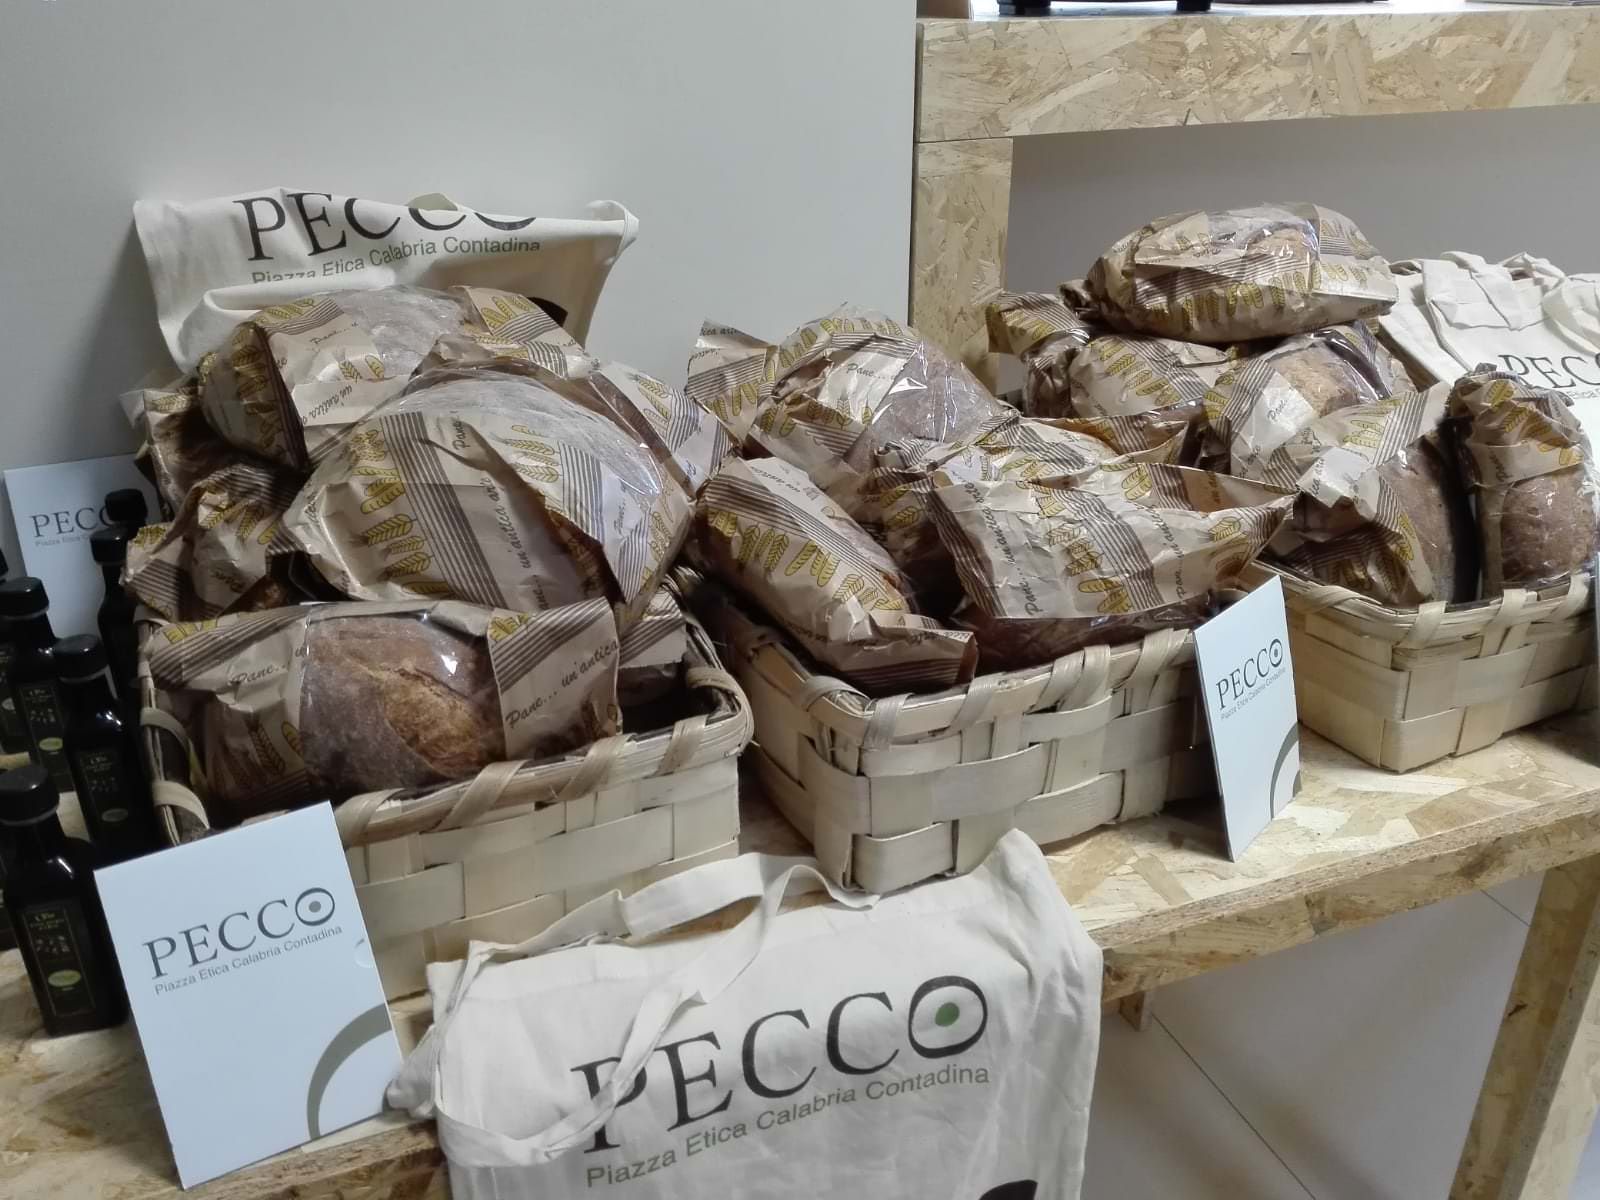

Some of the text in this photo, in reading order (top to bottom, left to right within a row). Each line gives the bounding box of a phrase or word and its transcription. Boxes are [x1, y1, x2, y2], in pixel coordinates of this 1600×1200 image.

[232, 192, 537, 261] PEC
[322, 256, 365, 277] Etica
[369, 239, 437, 266] Calabria
[443, 236, 541, 254] Contadina
[1497, 353, 1600, 389] PEC
[31, 506, 113, 538] PEC
[1215, 638, 1283, 711] PECCO
[142, 886, 336, 980] PECCO
[154, 925, 343, 995] Piazza Etica Calabria Contadina
[570, 975, 988, 1154] PECCO
[586, 1063, 990, 1188] Piazza Etica Calabria Contadina
